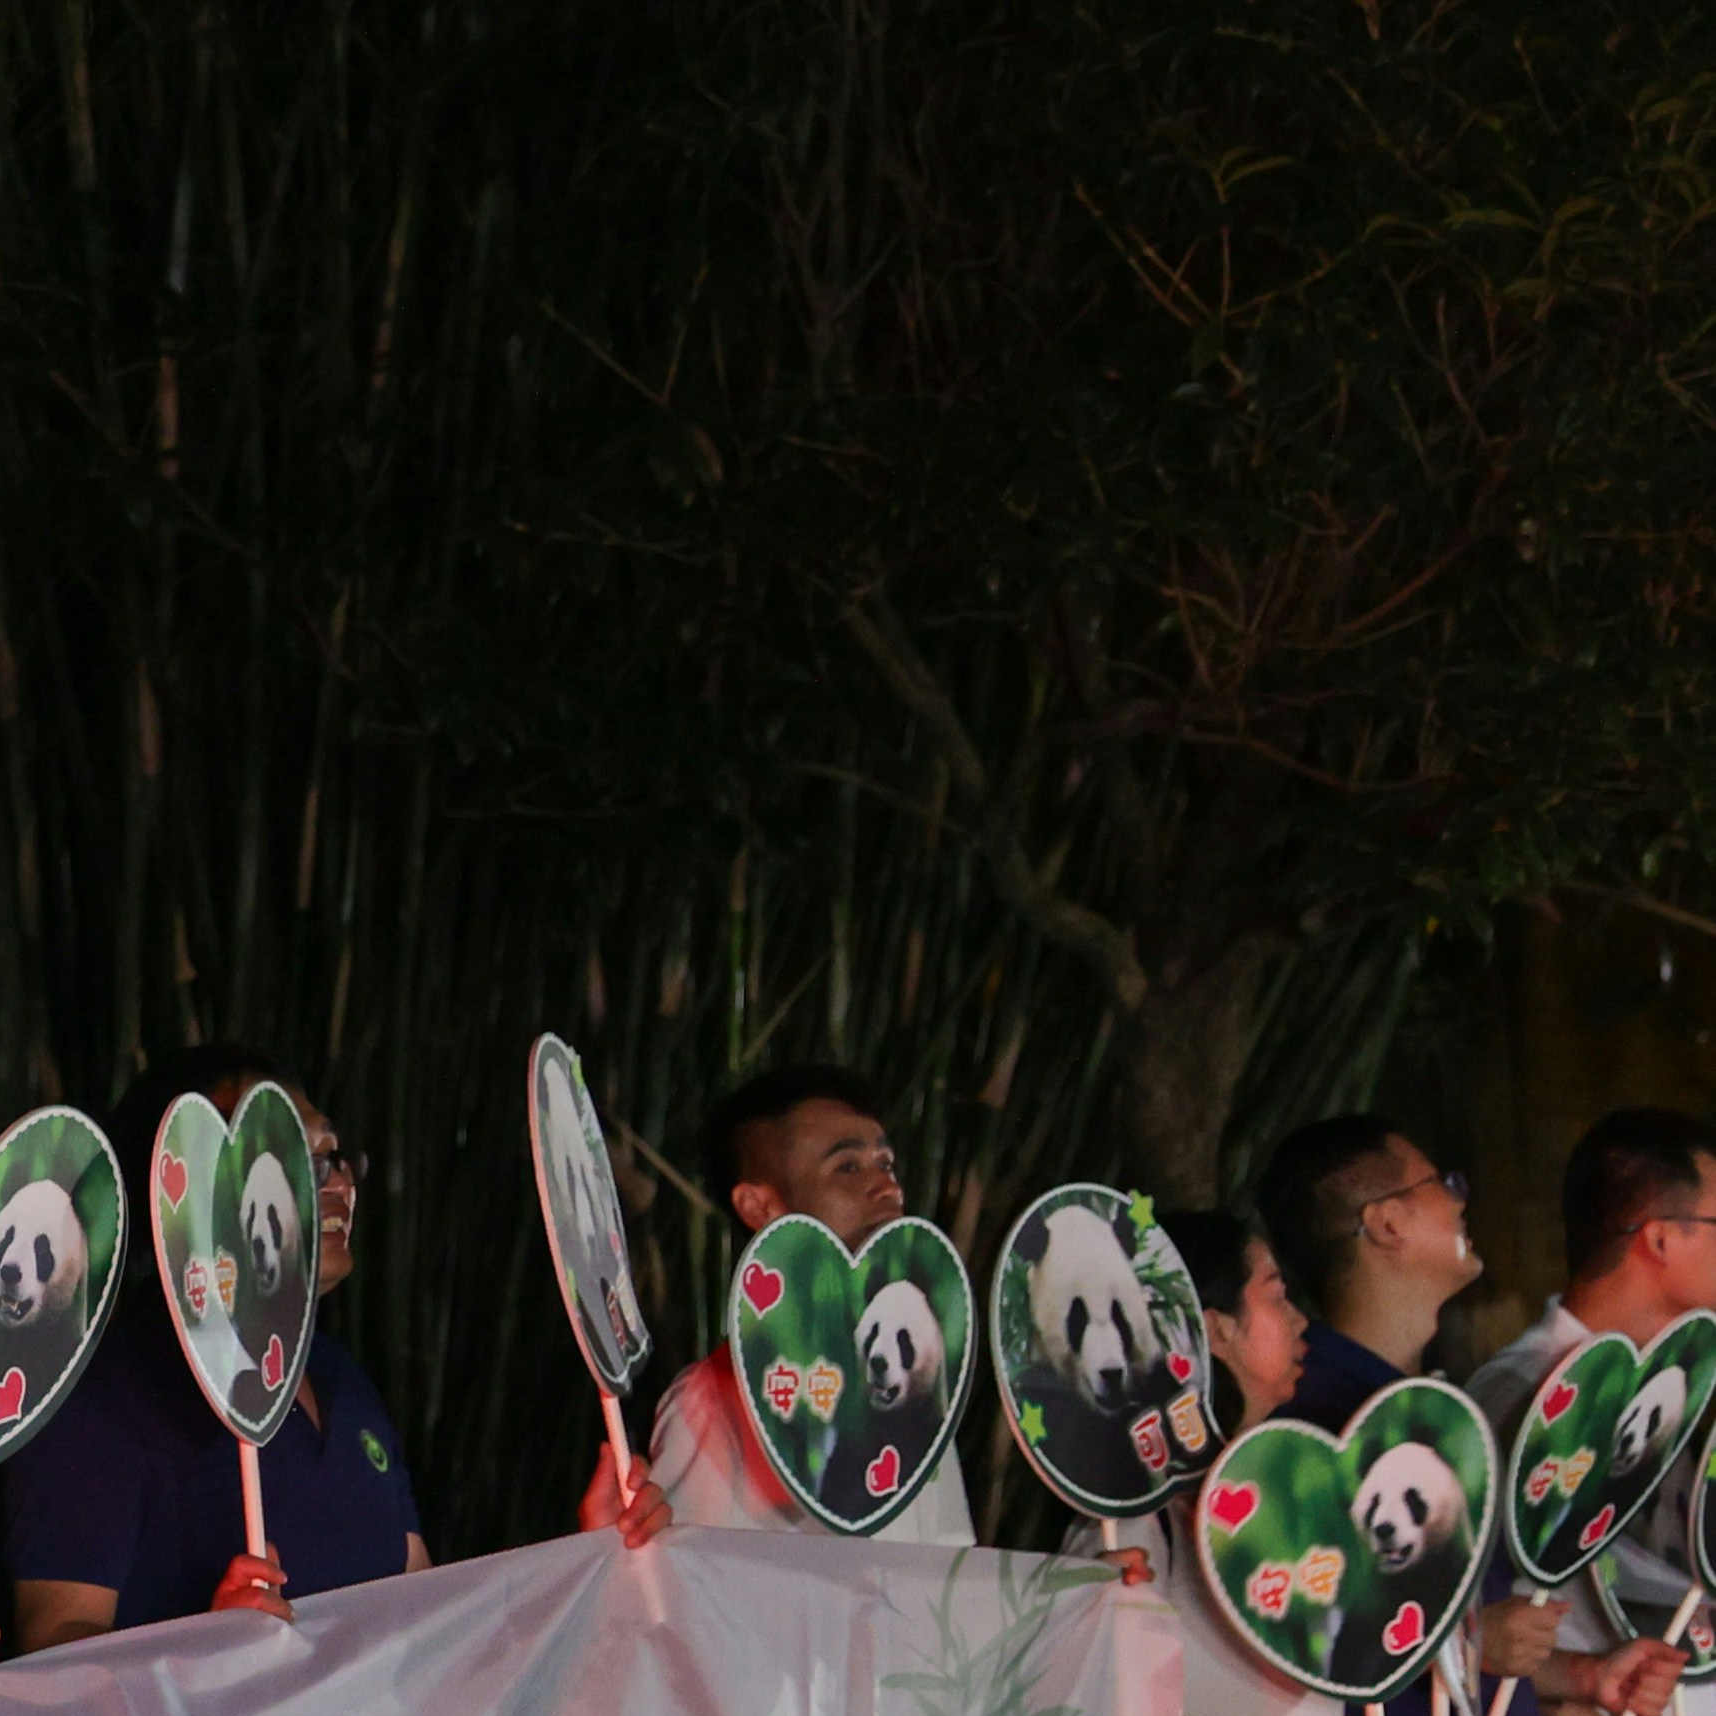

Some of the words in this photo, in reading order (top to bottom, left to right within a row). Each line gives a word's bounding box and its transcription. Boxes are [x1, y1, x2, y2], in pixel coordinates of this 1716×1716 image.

[766, 1358, 842, 1422] 安安
[1132, 1395, 1204, 1470] 可可
[1247, 1546, 1345, 1618] 安安
